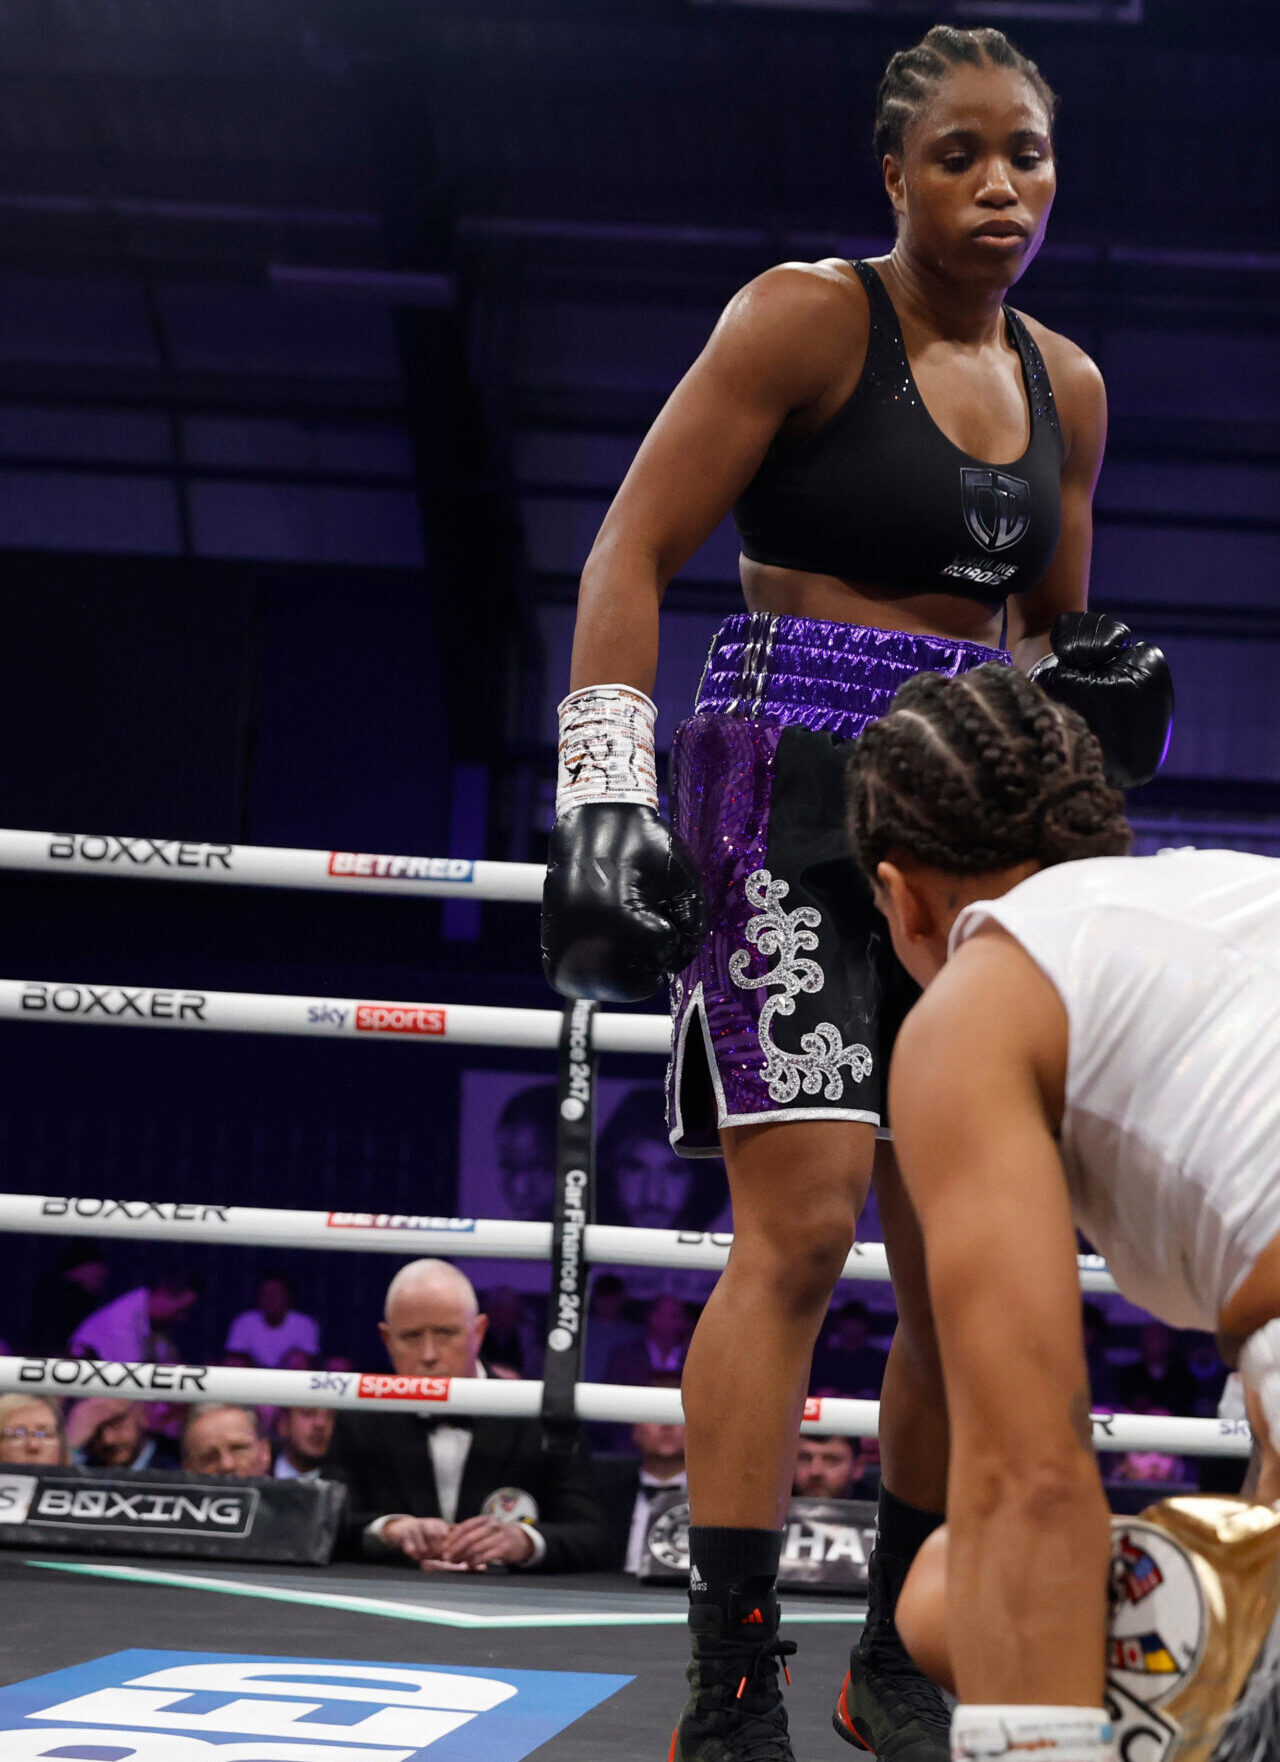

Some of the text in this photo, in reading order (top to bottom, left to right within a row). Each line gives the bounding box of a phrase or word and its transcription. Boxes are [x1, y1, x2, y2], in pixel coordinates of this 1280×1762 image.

[50, 832, 231, 868] BOXXER
[332, 852, 472, 880] BETFRED
[22, 983, 205, 1020] BOXXER
[308, 1004, 443, 1032] sky sports
[568, 1062, 591, 1102] 247
[557, 1169, 588, 1333] Car Finance 247
[20, 1357, 207, 1391] BOXXER
[310, 1371, 447, 1397] sky sports
[37, 1490, 241, 1525] BOXING
